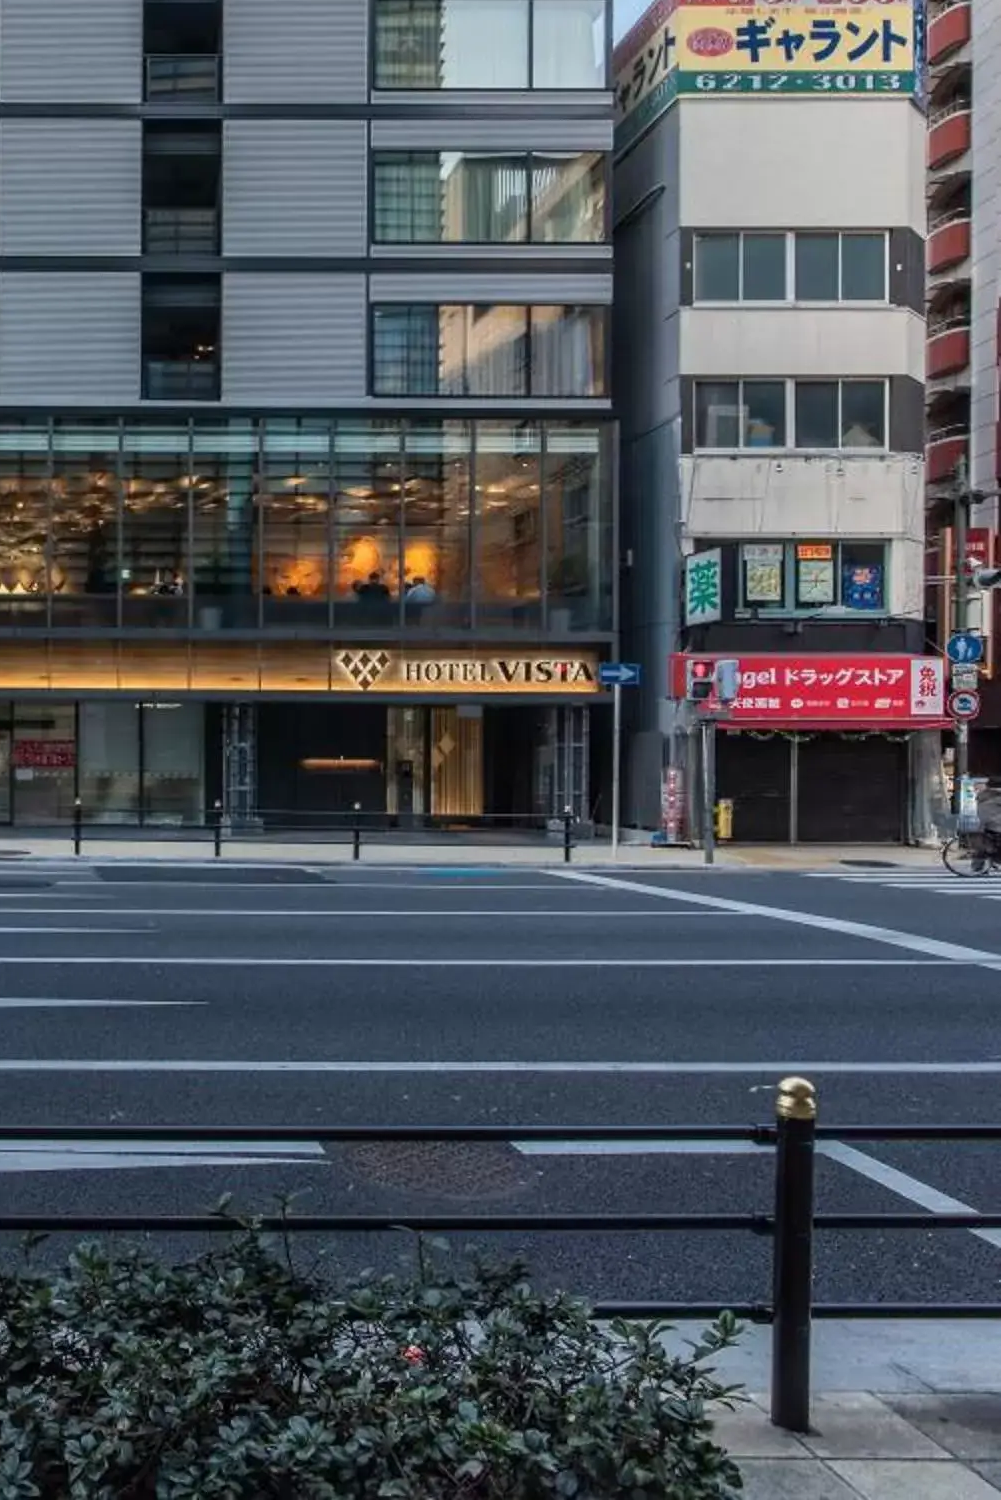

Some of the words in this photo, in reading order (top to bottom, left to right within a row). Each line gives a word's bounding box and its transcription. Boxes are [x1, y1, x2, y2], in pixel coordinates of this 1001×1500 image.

[736, 17, 908, 63] ギャラント
[688, 559, 718, 617] 薬
[405, 660, 494, 682] HOTEL
[497, 660, 595, 683] VISTA
[785, 668, 904, 687] ドラッグストア
[919, 665, 937, 698] 免税
